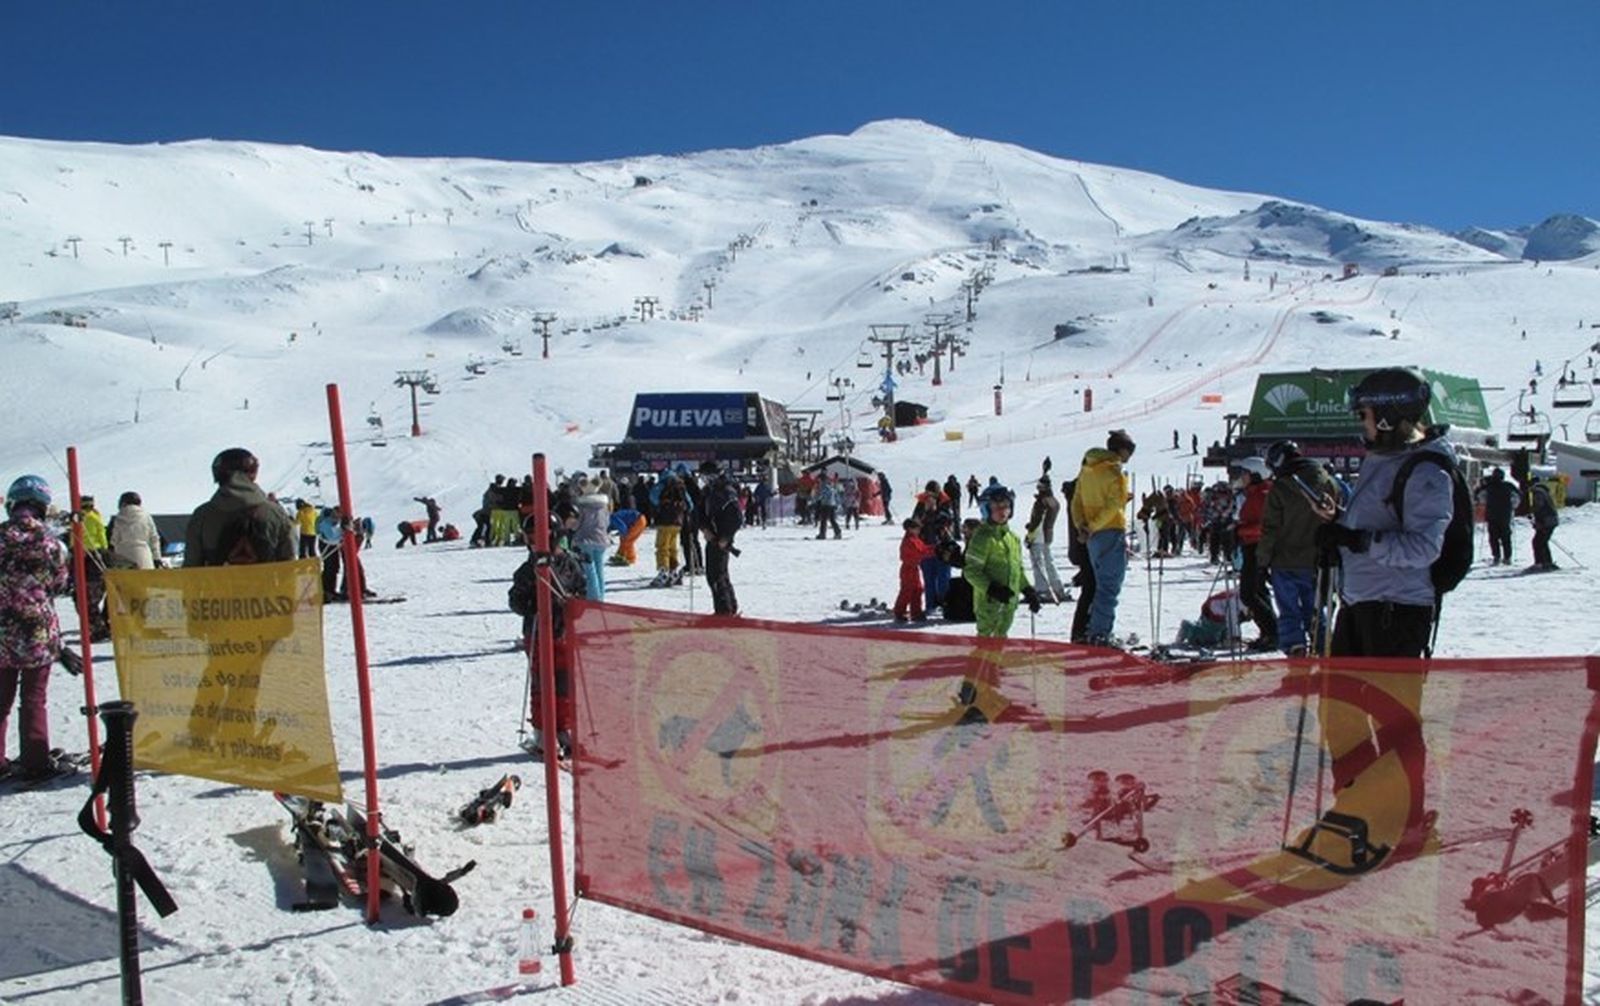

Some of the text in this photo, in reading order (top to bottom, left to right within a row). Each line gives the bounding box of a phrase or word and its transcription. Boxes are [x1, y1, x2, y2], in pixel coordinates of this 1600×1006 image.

[634, 407, 723, 427] PULEVA
[1306, 399, 1355, 416] Unica
[131, 594, 294, 621] POR SU SEGURIDAD
[647, 817, 726, 919] EN
[737, 840, 910, 964] ZONA
[936, 875, 1035, 997] DE
